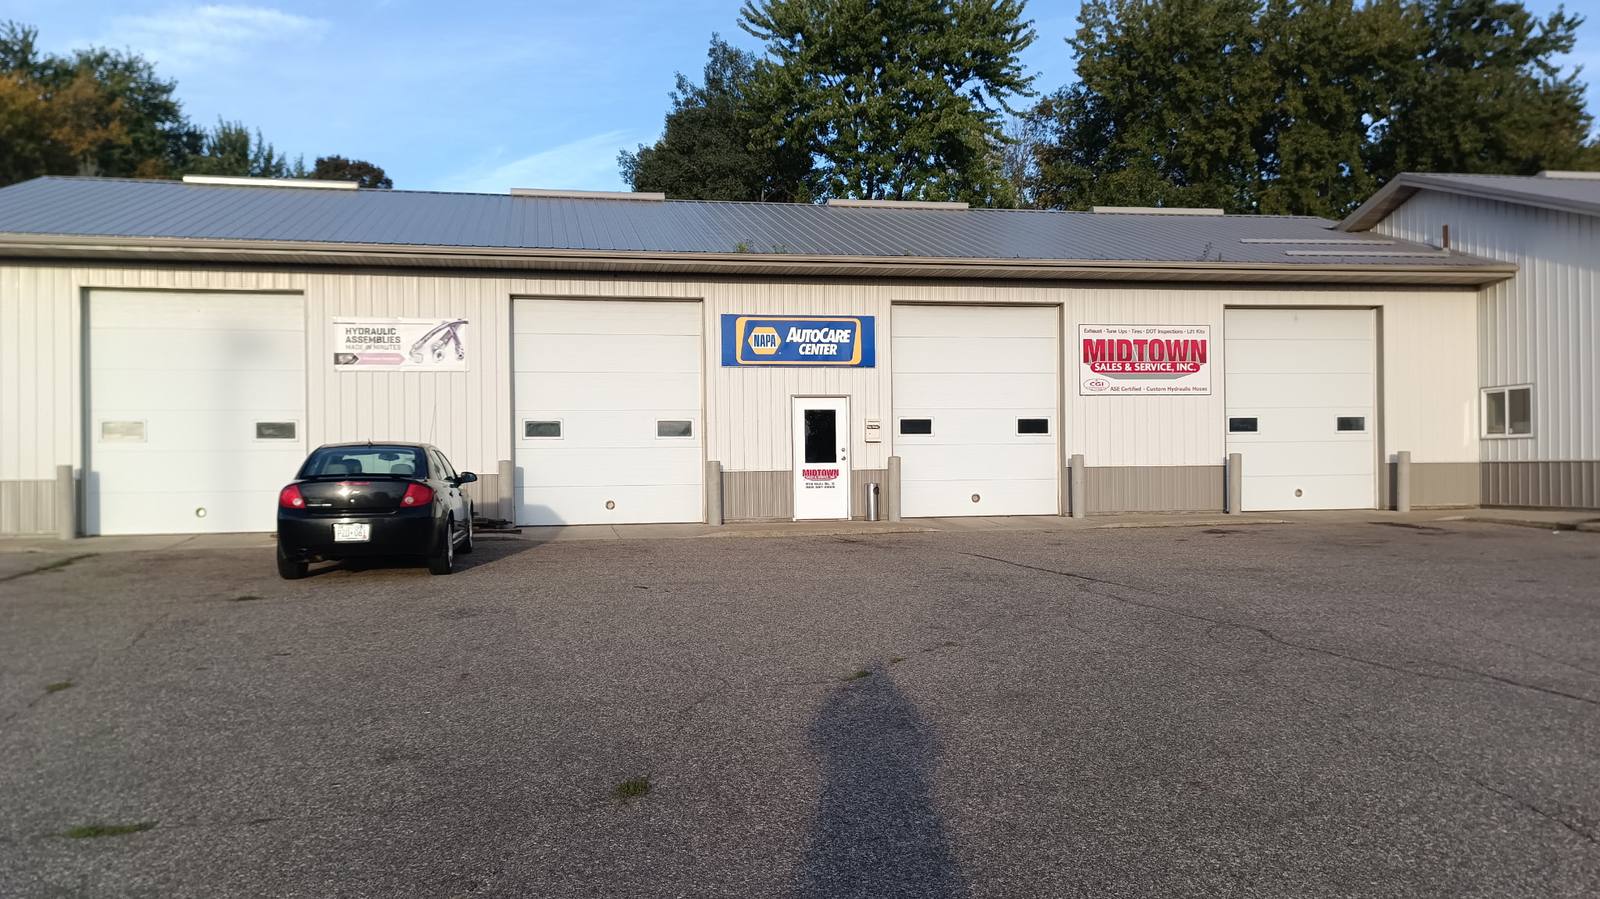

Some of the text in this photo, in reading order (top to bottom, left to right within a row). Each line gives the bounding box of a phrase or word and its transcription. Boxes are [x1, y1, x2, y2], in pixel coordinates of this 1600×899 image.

[753, 334, 776, 347] NAPA
[799, 344, 837, 355] CENTER
[1083, 339, 1207, 363] MIDTOWN
[1094, 363, 1197, 372] SALES & SERVICE, INC.
